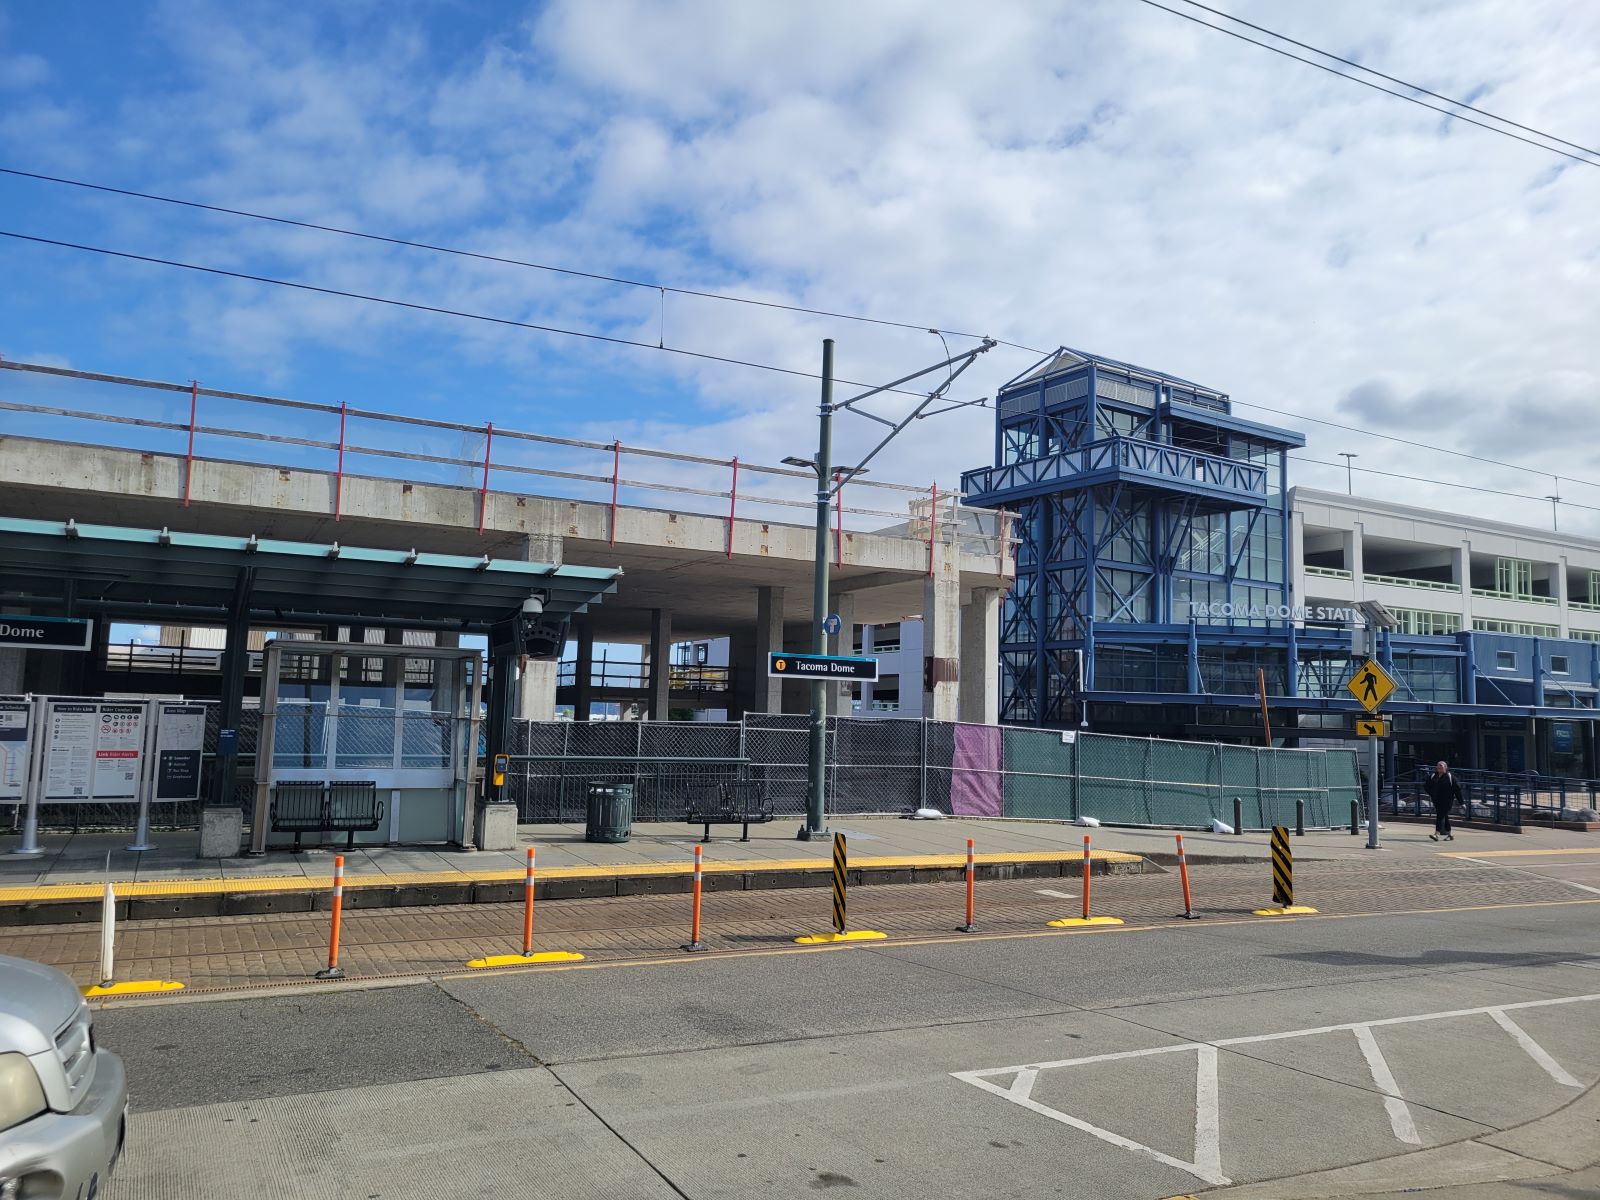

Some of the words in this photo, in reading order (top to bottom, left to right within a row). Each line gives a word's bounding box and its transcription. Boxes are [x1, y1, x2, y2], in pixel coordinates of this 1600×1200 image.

[1190, 601, 1260, 617] TACOMA
[1265, 604, 1313, 619] DOME
[0, 624, 45, 638] Dome
[796, 660, 828, 672] Tacoma
[831, 662, 855, 673] Dome
